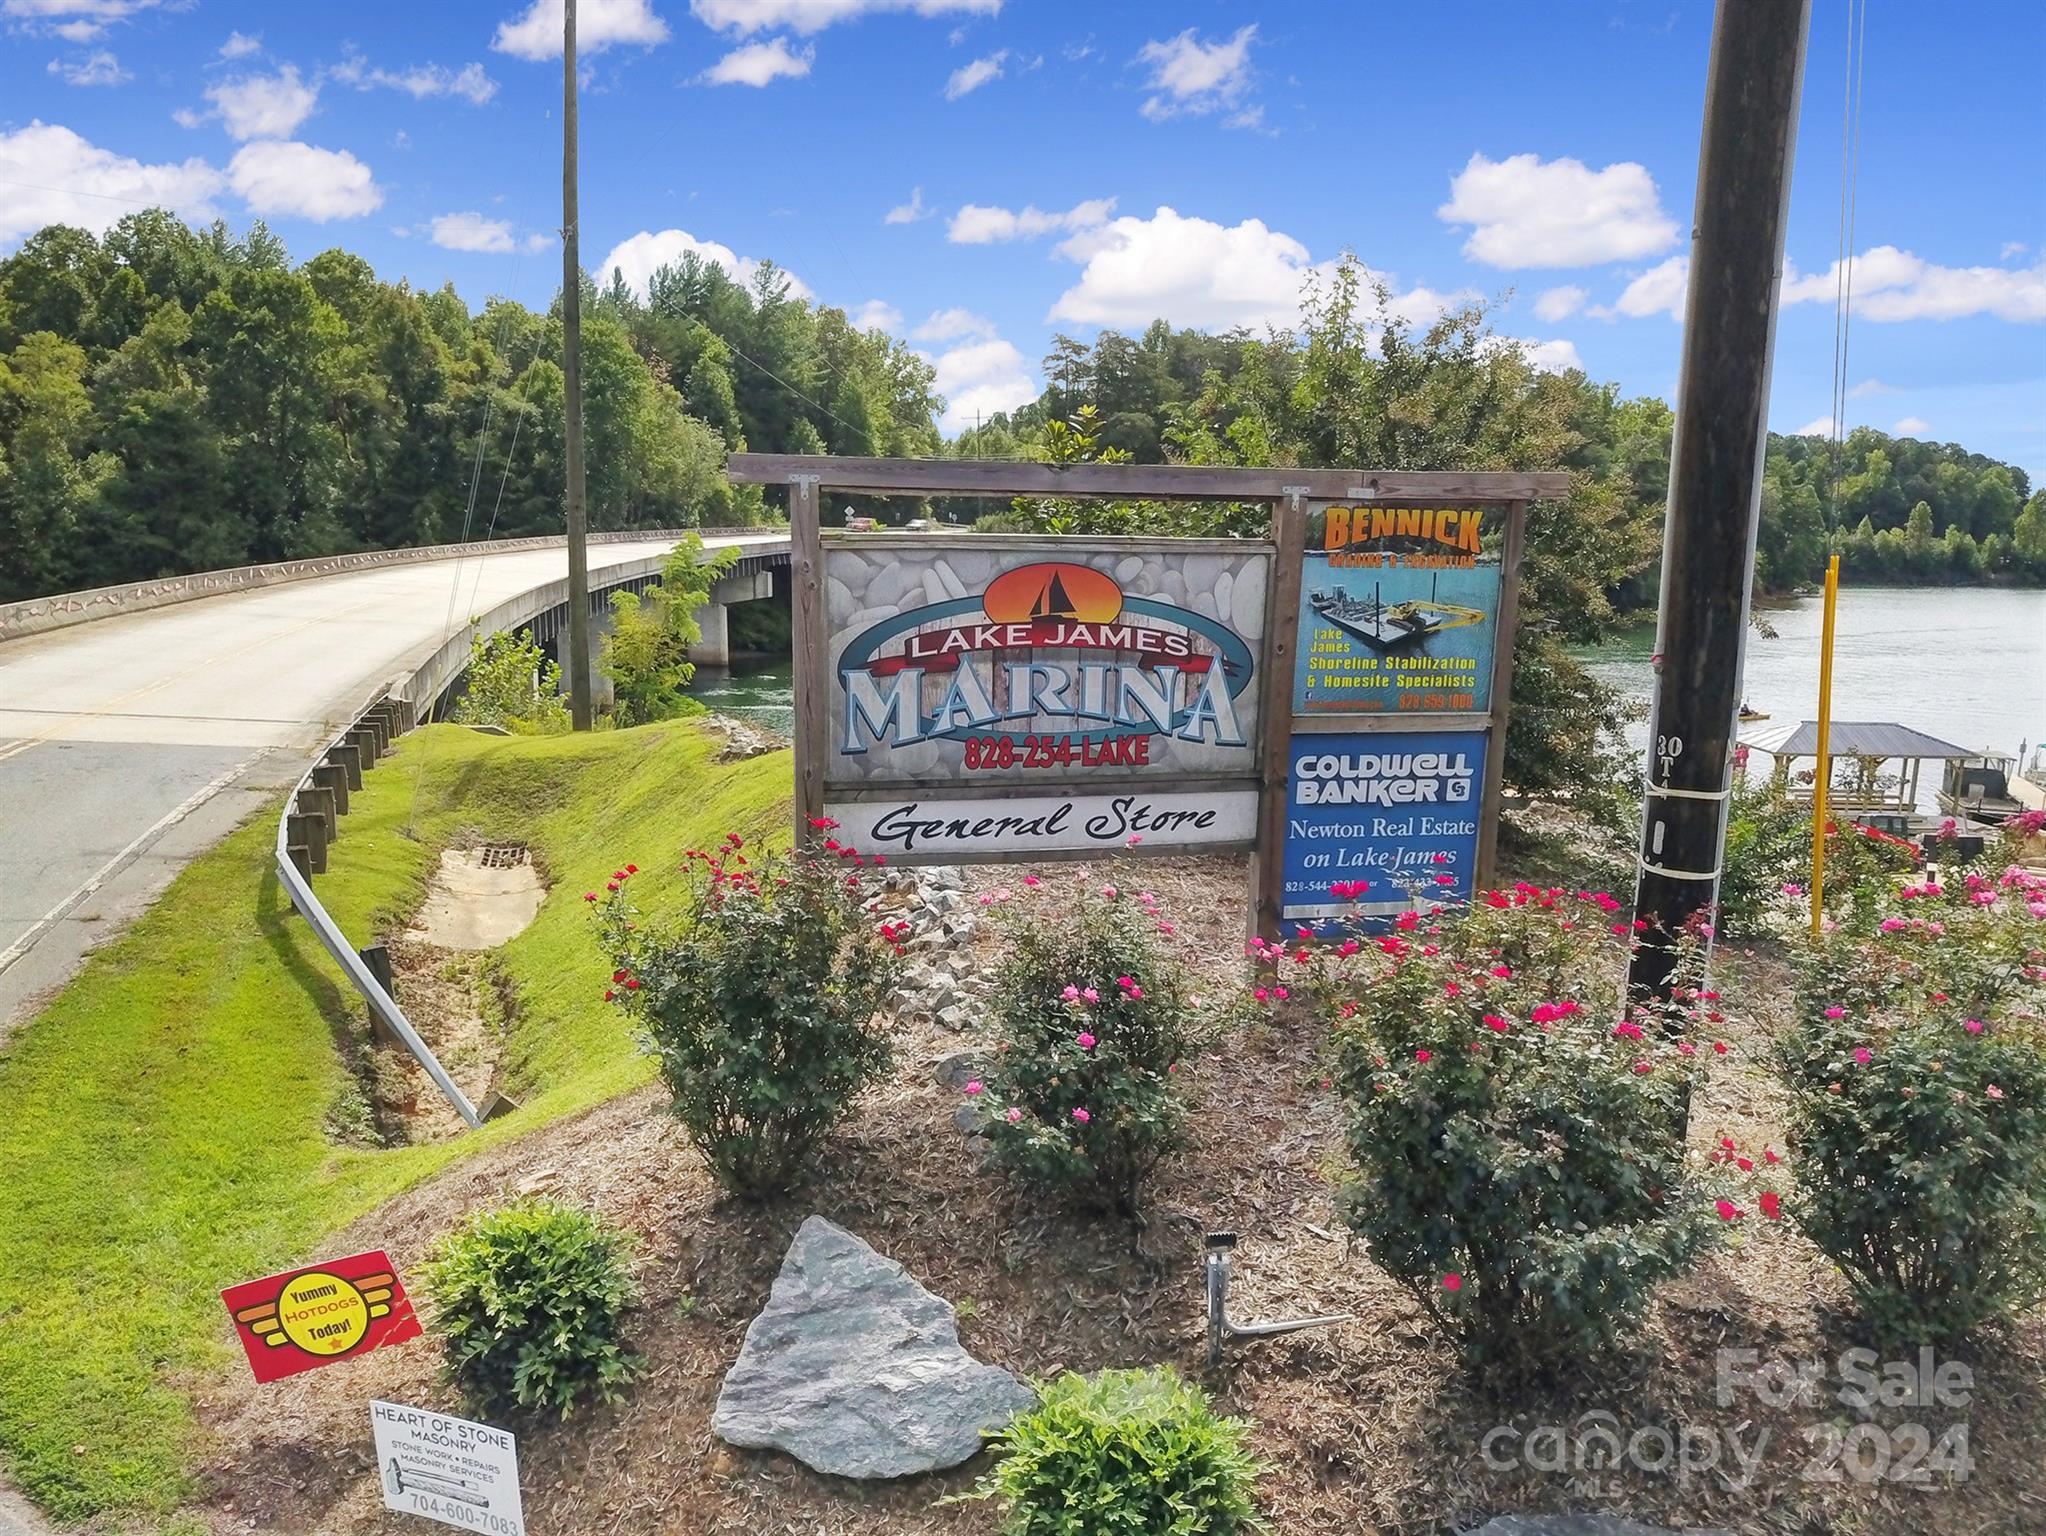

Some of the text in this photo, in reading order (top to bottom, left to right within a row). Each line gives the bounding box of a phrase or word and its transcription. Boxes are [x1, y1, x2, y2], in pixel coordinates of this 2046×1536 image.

[1324, 507, 1484, 554] BENNICK
[910, 622, 1191, 659] LAKE JAMES
[1310, 641, 1350, 653] James
[1314, 628, 1343, 641] Lake
[1309, 656, 1476, 670] Shoreline Stabilization
[1307, 674, 1475, 689] & Homesite Specialists
[840, 655, 1248, 755] MARINA
[963, 734, 1150, 771] 828-254-LAKE
[1657, 735, 1683, 758] 30
[1295, 753, 1474, 779] COLDWELL
[1296, 778, 1439, 807] BANKER
[871, 796, 1218, 851] General Store
[1289, 816, 1475, 839] Newton Real Estate
[1303, 847, 1457, 870] on Lake James
[1369, 880, 1378, 888] or
[290, 1283, 338, 1304] Yummy
[284, 1296, 359, 1324] HOTDOGS
[307, 1318, 352, 1341] Today!
[375, 1406, 510, 1451] HEART OF STONE
[410, 1429, 477, 1454] MASONRY
[391, 1440, 501, 1475] STONE WORK REPAIRS
[400, 1454, 495, 1484] MASONRY SERVICES
[409, 1492, 518, 1536] 704-600-7083
